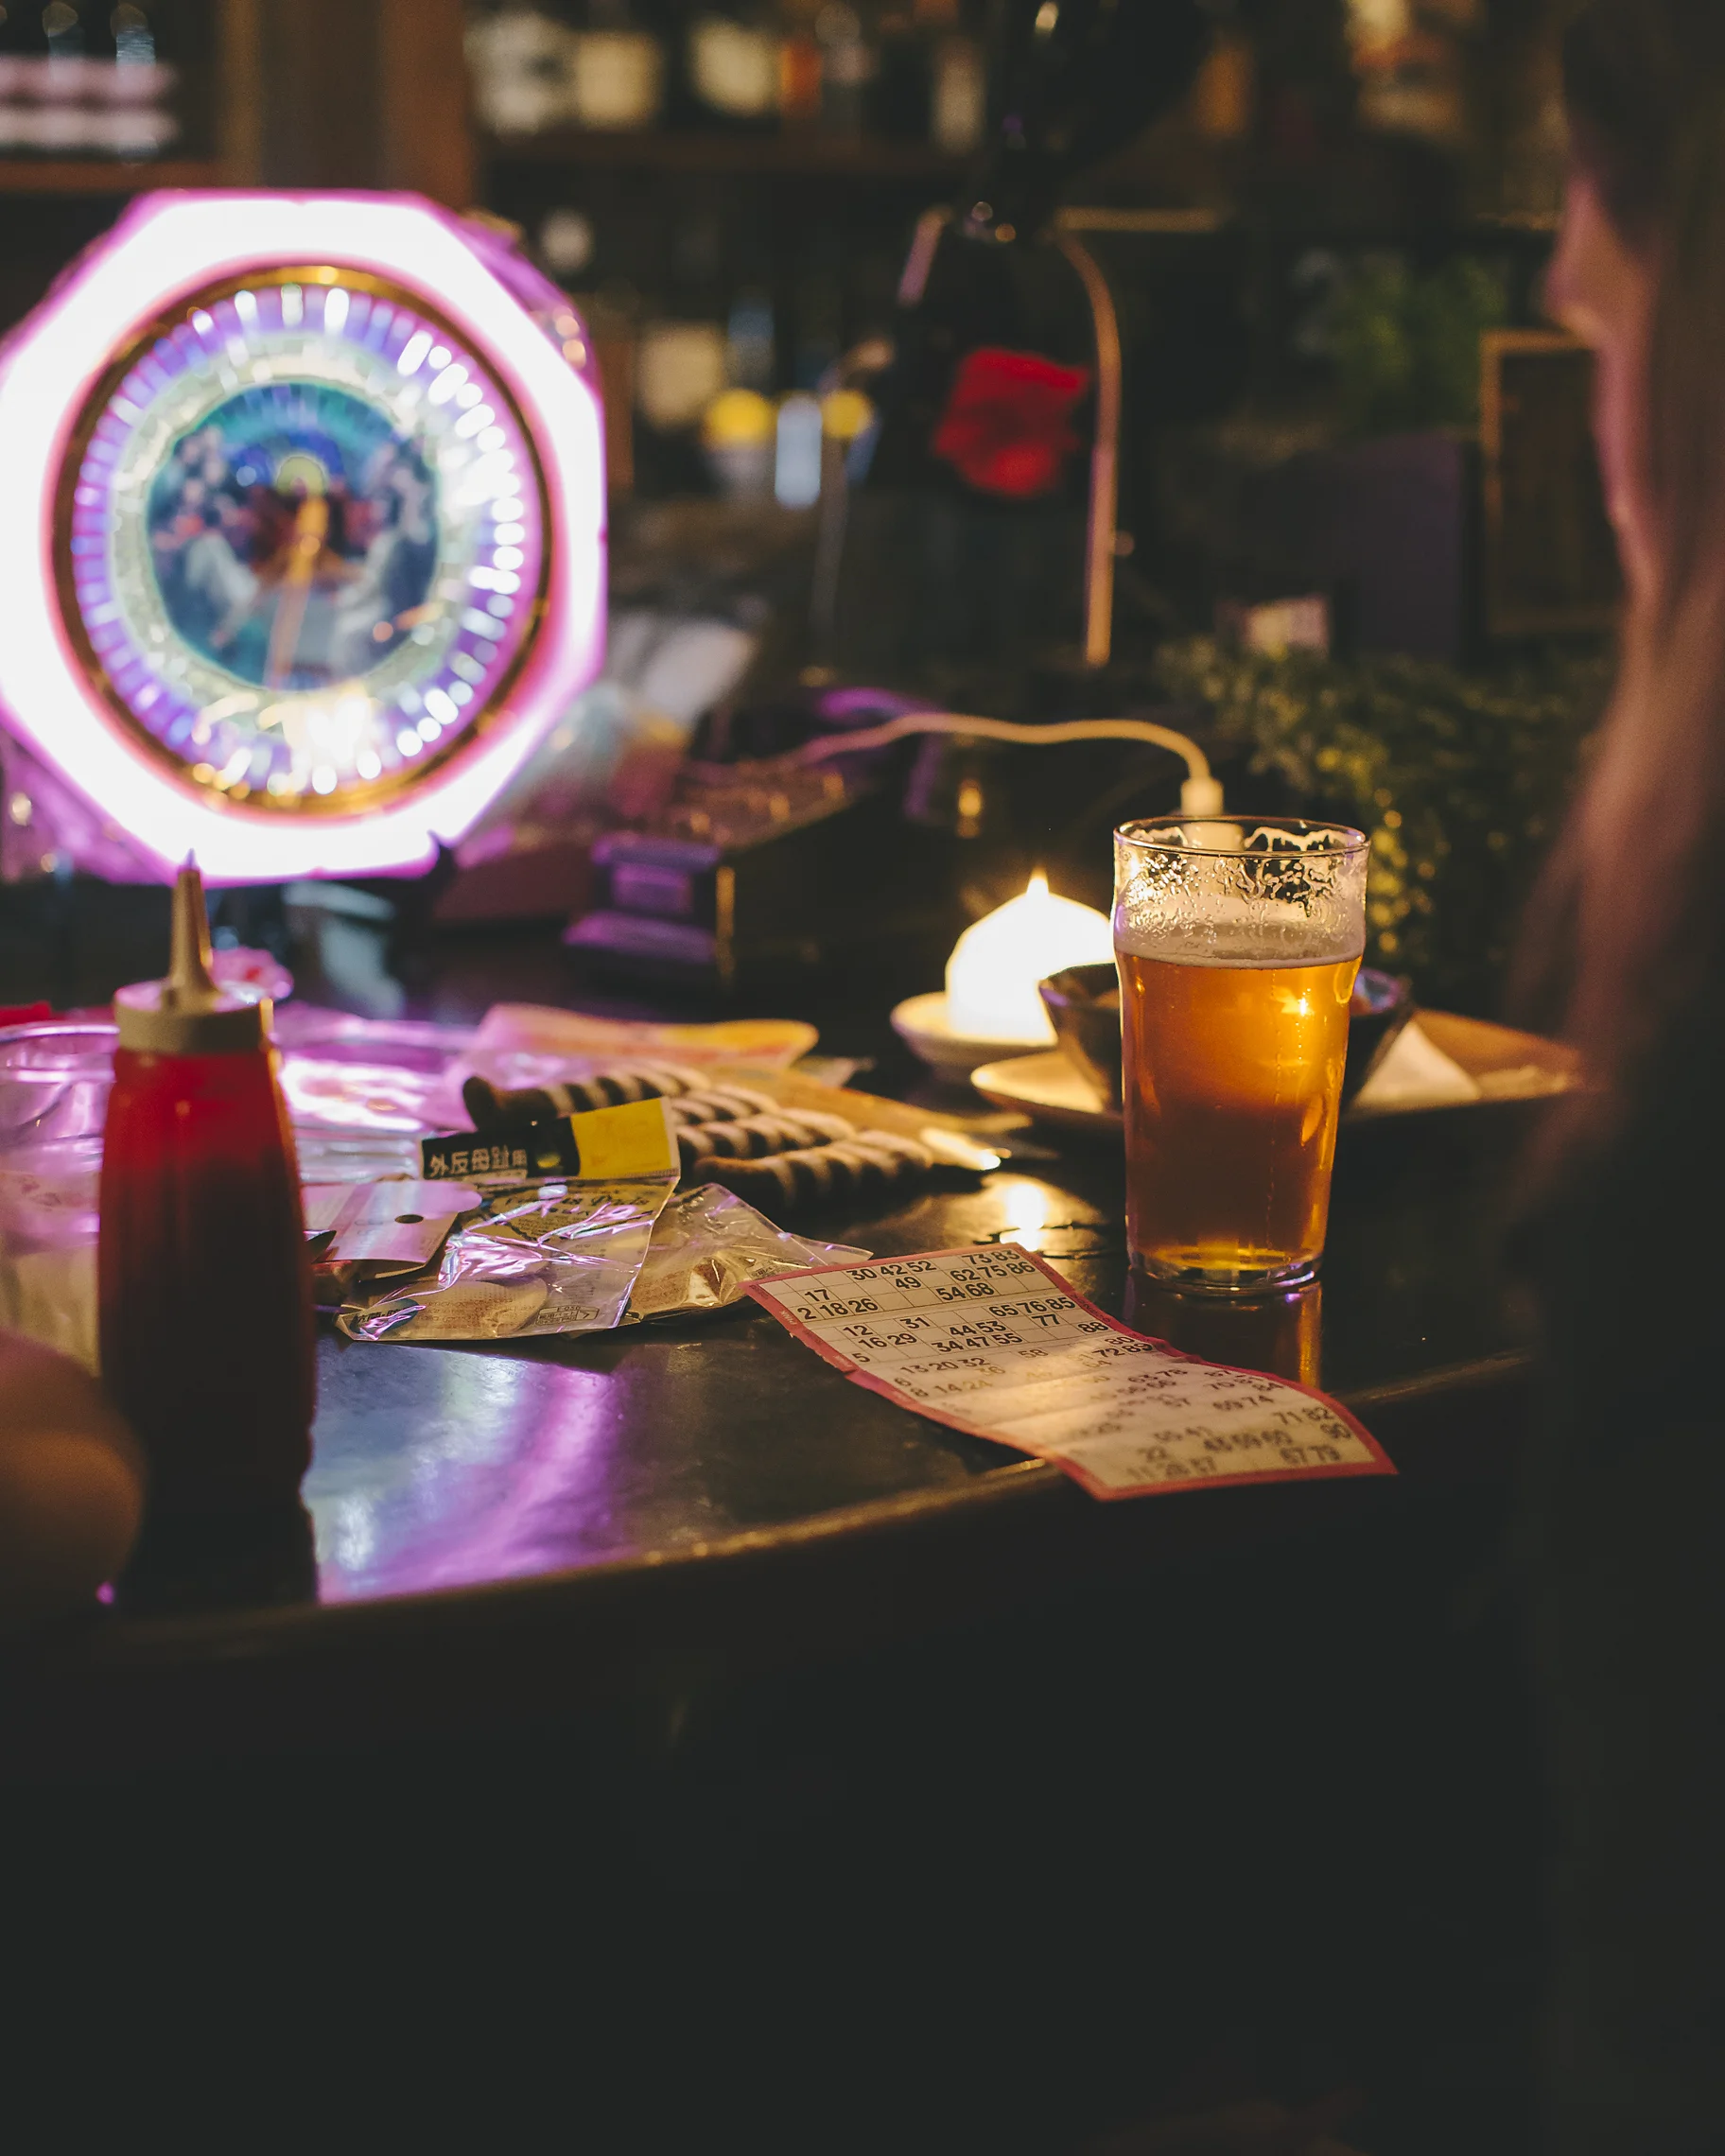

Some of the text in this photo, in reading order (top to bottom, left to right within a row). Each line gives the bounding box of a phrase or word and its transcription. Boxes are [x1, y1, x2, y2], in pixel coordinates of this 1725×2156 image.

[804, 1261, 1036, 1302] 17 49 62 75 86
[845, 1249, 1020, 1280] 30 42 52 73 83
[797, 1282, 995, 1320] 2 18 26 54 68
[843, 1325, 874, 1337] 12
[899, 1316, 931, 1330] 31
[988, 1305, 1019, 1317] 65
[1015, 1300, 1048, 1313] 76
[1045, 1296, 1076, 1310] 85
[852, 1352, 871, 1363] 5
[932, 1340, 965, 1352] 34
[966, 1336, 990, 1348] 47
[991, 1332, 1023, 1345] 55
[1077, 1321, 1109, 1333] 88
[859, 1313, 1060, 1349] 16 29 44 53 77
[894, 1377, 912, 1387] 6
[1091, 1348, 1125, 1357] 72
[1121, 1343, 1153, 1353] 89
[900, 1336, 1135, 1374] 13 20 32 58 80
[933, 1382, 963, 1395] 14
